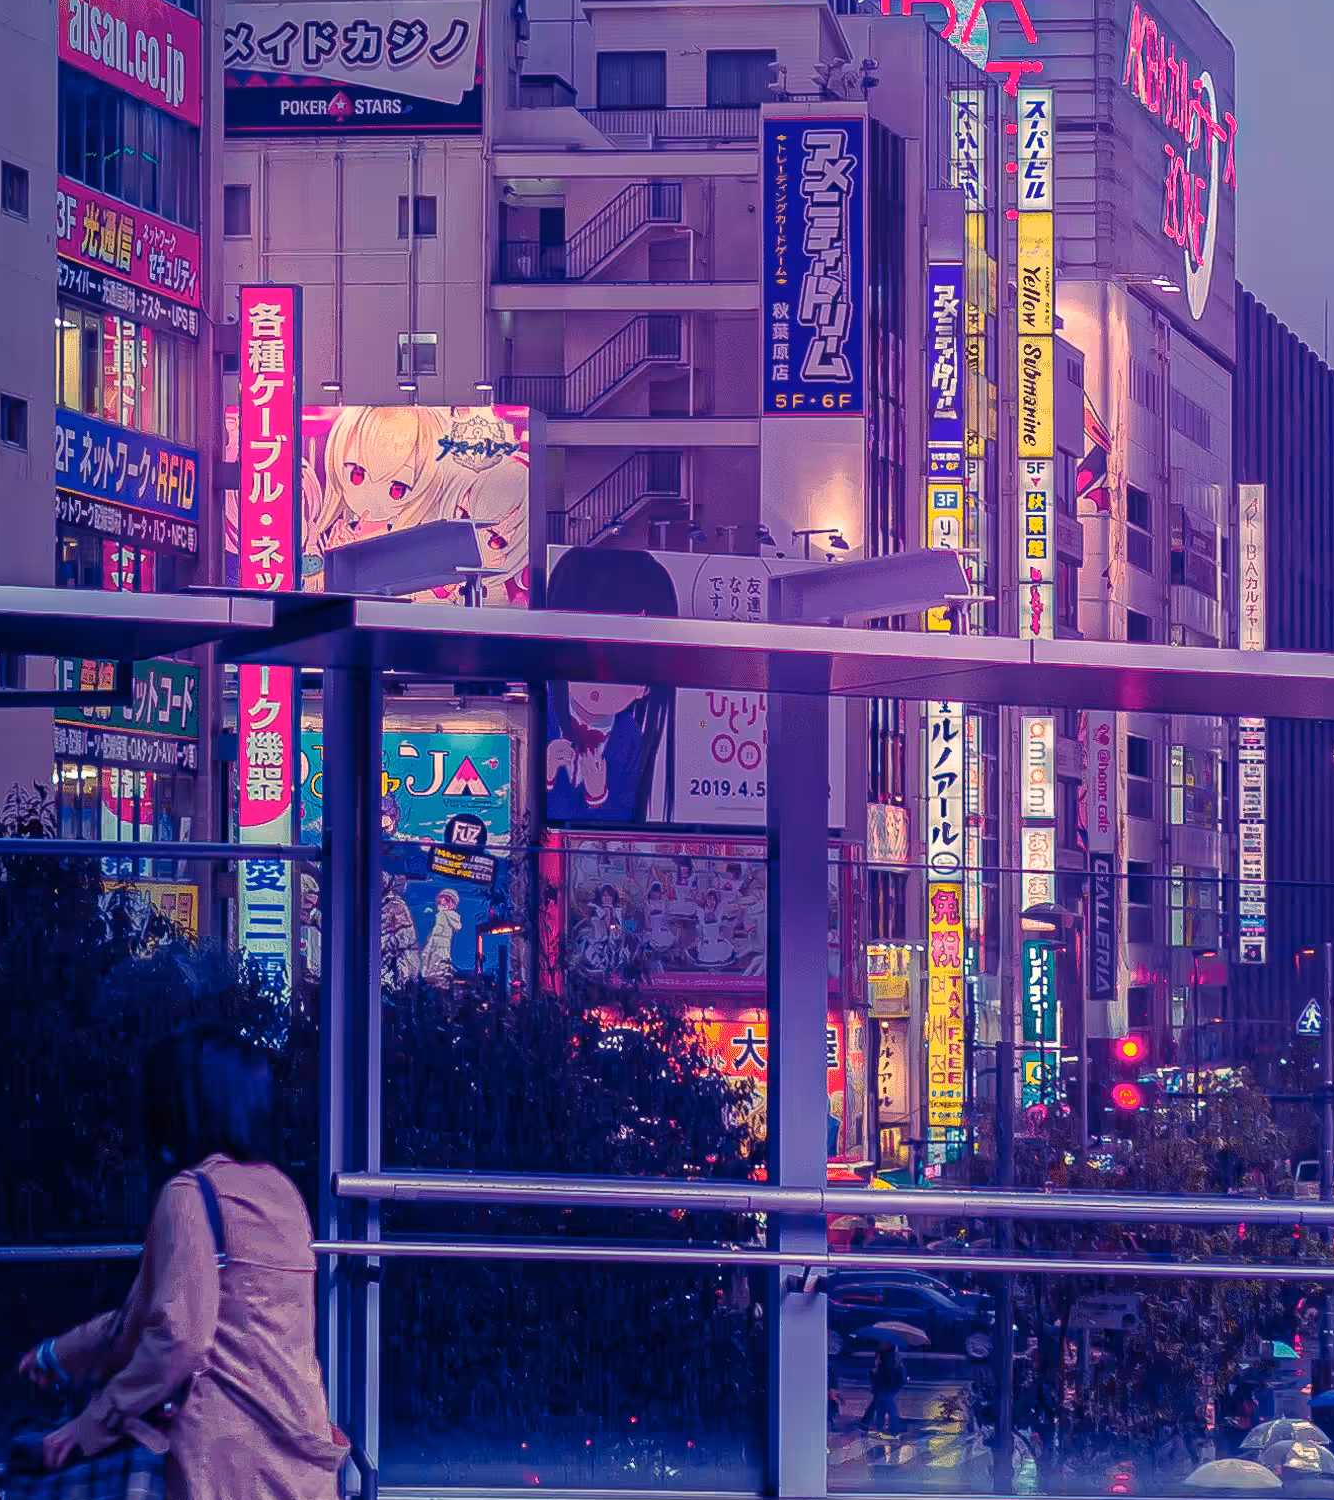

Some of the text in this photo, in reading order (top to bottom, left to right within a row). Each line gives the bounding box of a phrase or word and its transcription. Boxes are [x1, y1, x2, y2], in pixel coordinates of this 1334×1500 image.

[225, 20, 468, 65] メイドカジノ
[280, 100, 402, 116] POKER STARS
[1024, 100, 1049, 199] スーパービル
[1022, 266, 1041, 327] Yellow
[772, 302, 789, 381] 秋葉原店
[1023, 343, 1042, 447] Submarine
[936, 494, 956, 507] 3F
[1027, 462, 1045, 474] 5F
[690, 779, 766, 798] 2019.4.5
[1029, 721, 1046, 814] amiami
[1095, 858, 1110, 993] GALLERIA
[948, 976, 960, 1085] TAX FREE
